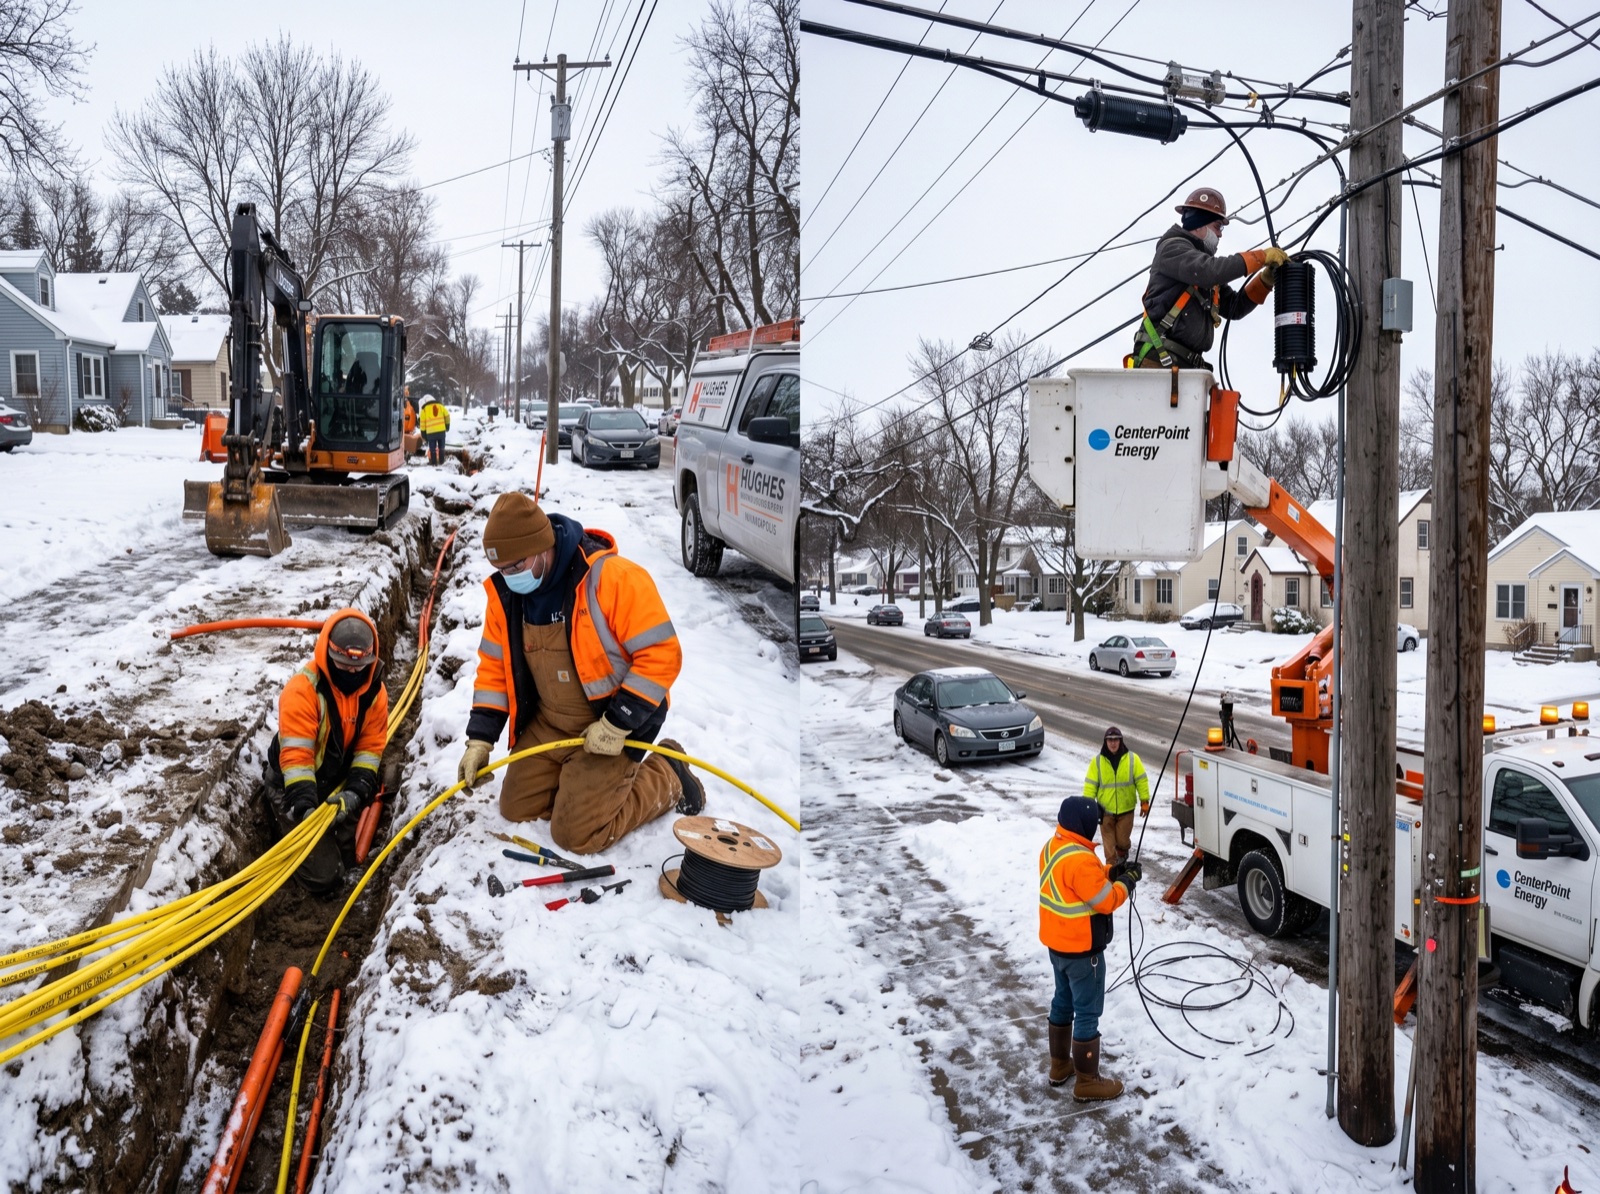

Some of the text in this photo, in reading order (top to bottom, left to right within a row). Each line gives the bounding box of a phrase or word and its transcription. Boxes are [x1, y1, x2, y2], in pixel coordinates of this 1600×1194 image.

[702, 381, 728, 396] HUGHES
[1114, 425, 1190, 440] CenterPoint
[1114, 442, 1160, 461] Energy
[740, 467, 786, 501] HUGHES
[1514, 870, 1571, 900] CenterPoint
[1514, 886, 1548, 910] Energy
